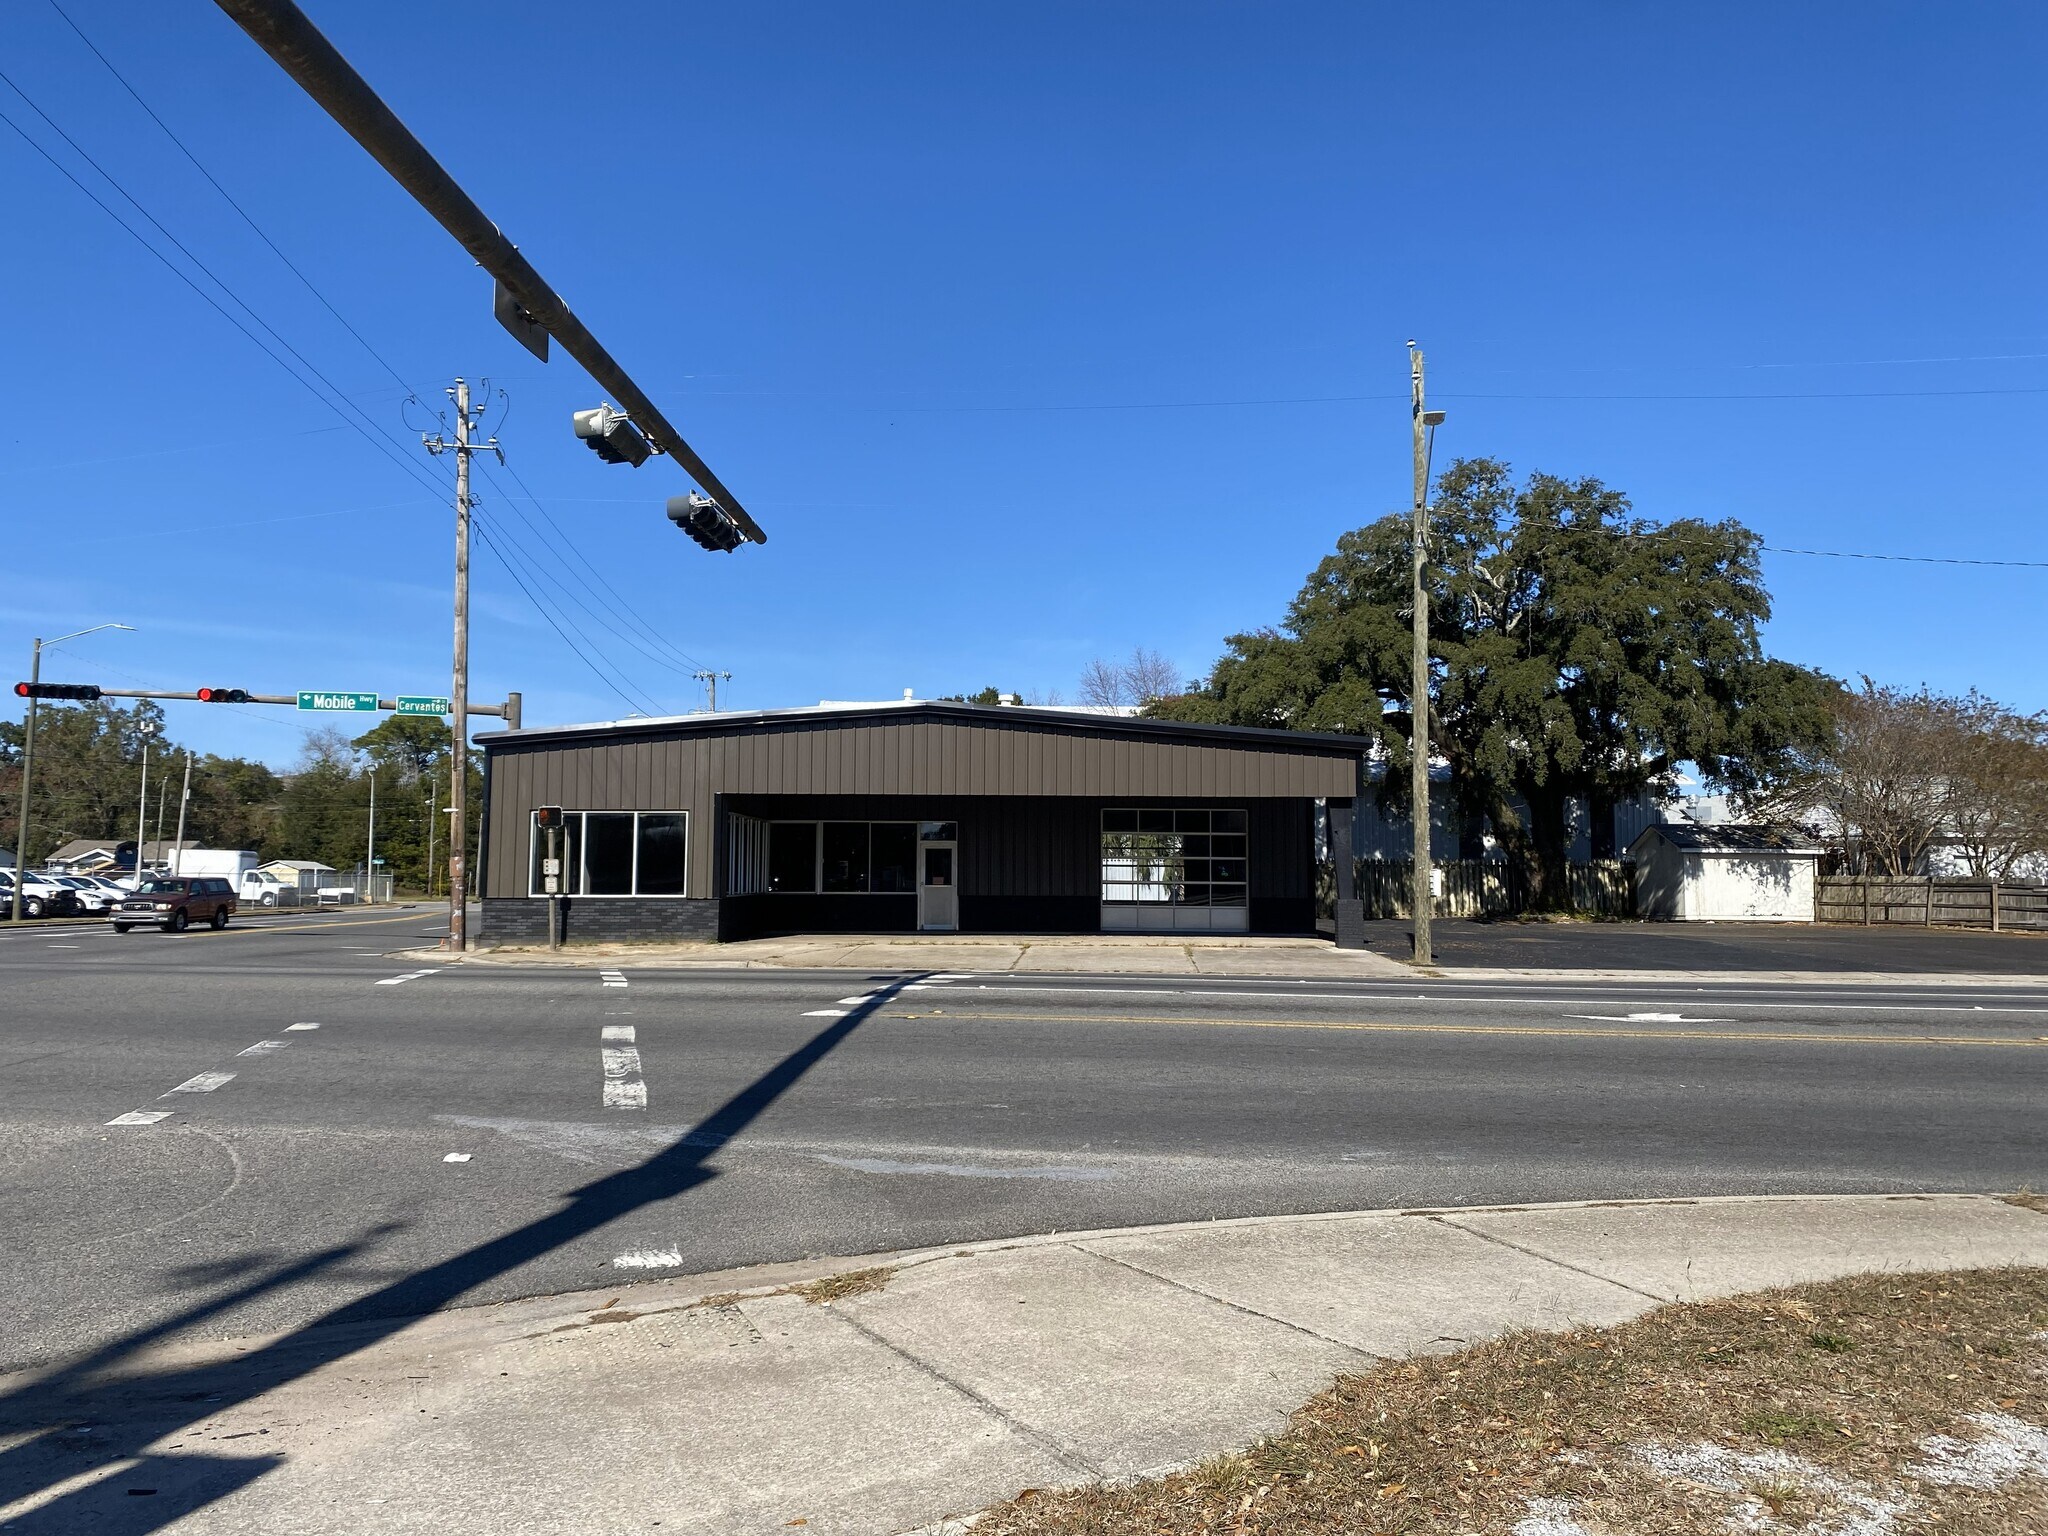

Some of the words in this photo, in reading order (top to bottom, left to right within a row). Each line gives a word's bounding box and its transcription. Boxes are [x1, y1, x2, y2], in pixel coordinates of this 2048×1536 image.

[313, 694, 356, 709] Mobile
[359, 695, 374, 703] Hwy
[398, 700, 446, 712] Cervantes
